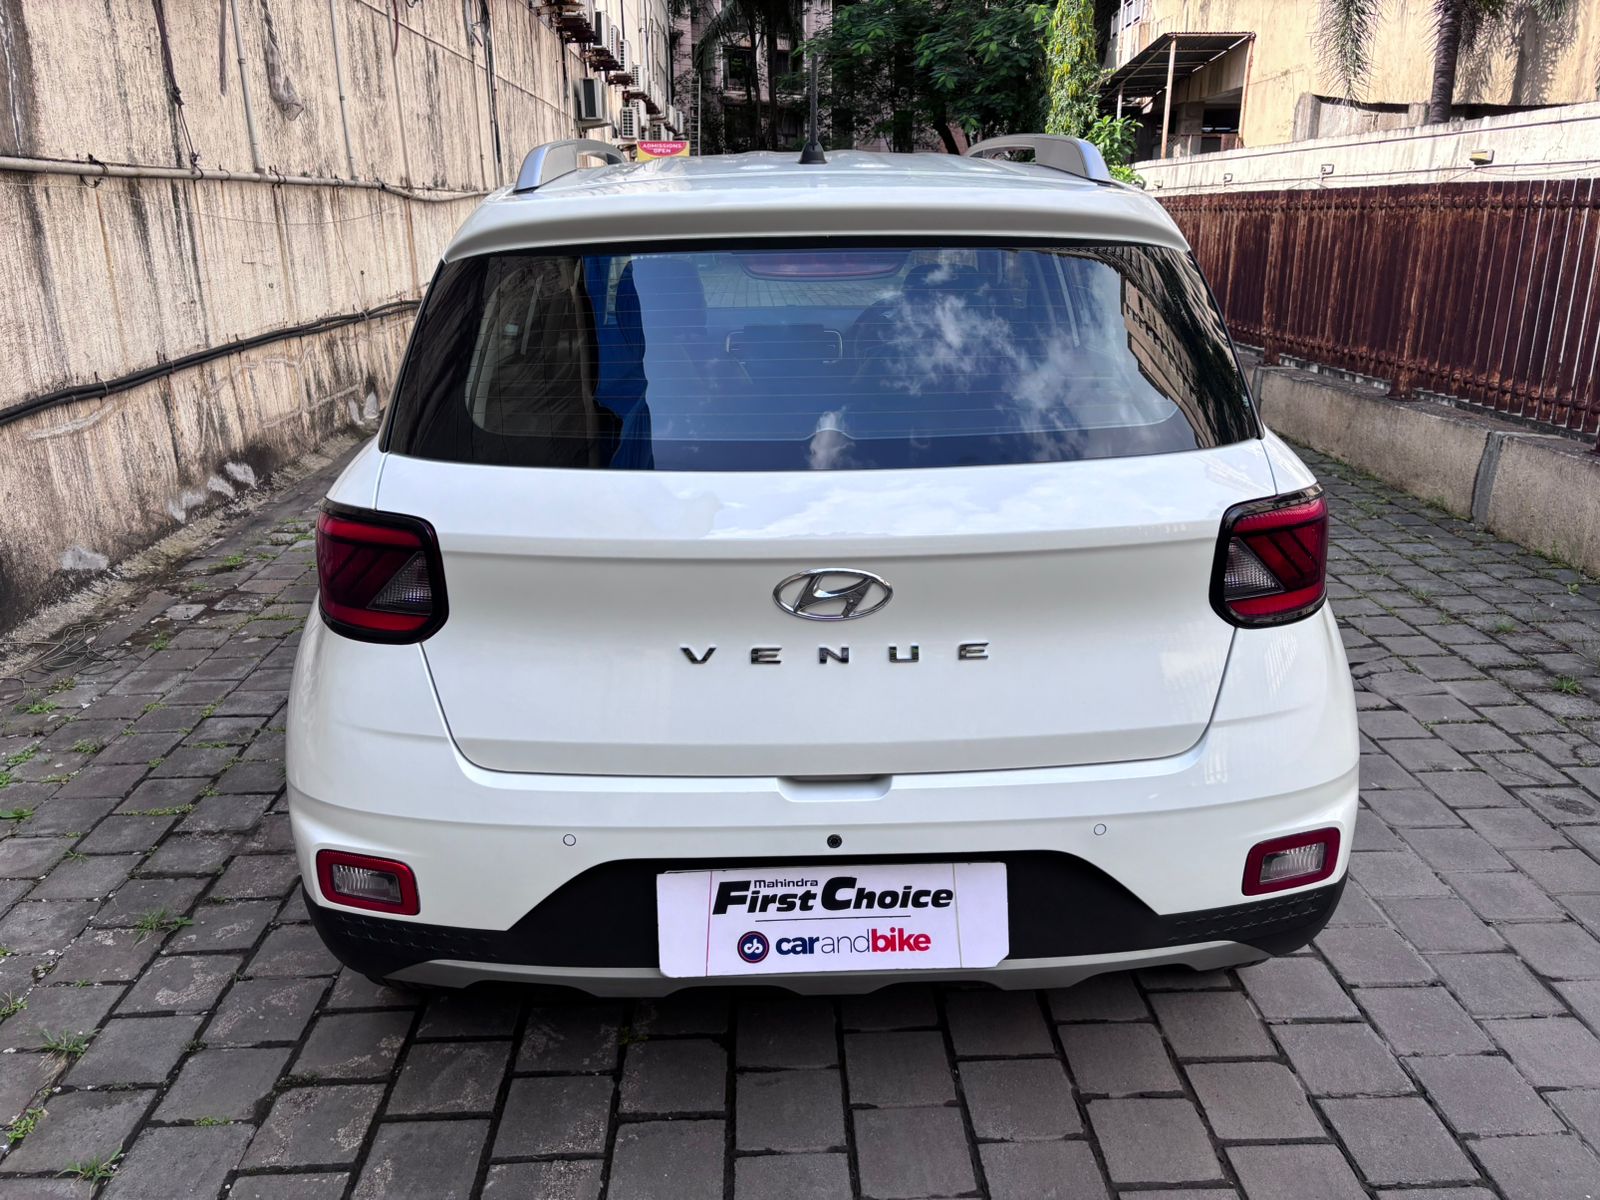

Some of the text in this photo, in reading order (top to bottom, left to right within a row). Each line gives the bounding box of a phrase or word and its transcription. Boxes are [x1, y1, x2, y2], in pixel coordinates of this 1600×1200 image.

[680, 642, 990, 665] VENUE
[712, 876, 954, 915] First Choice
[753, 878, 818, 889] Mahindra
[775, 927, 932, 956] carandbike
